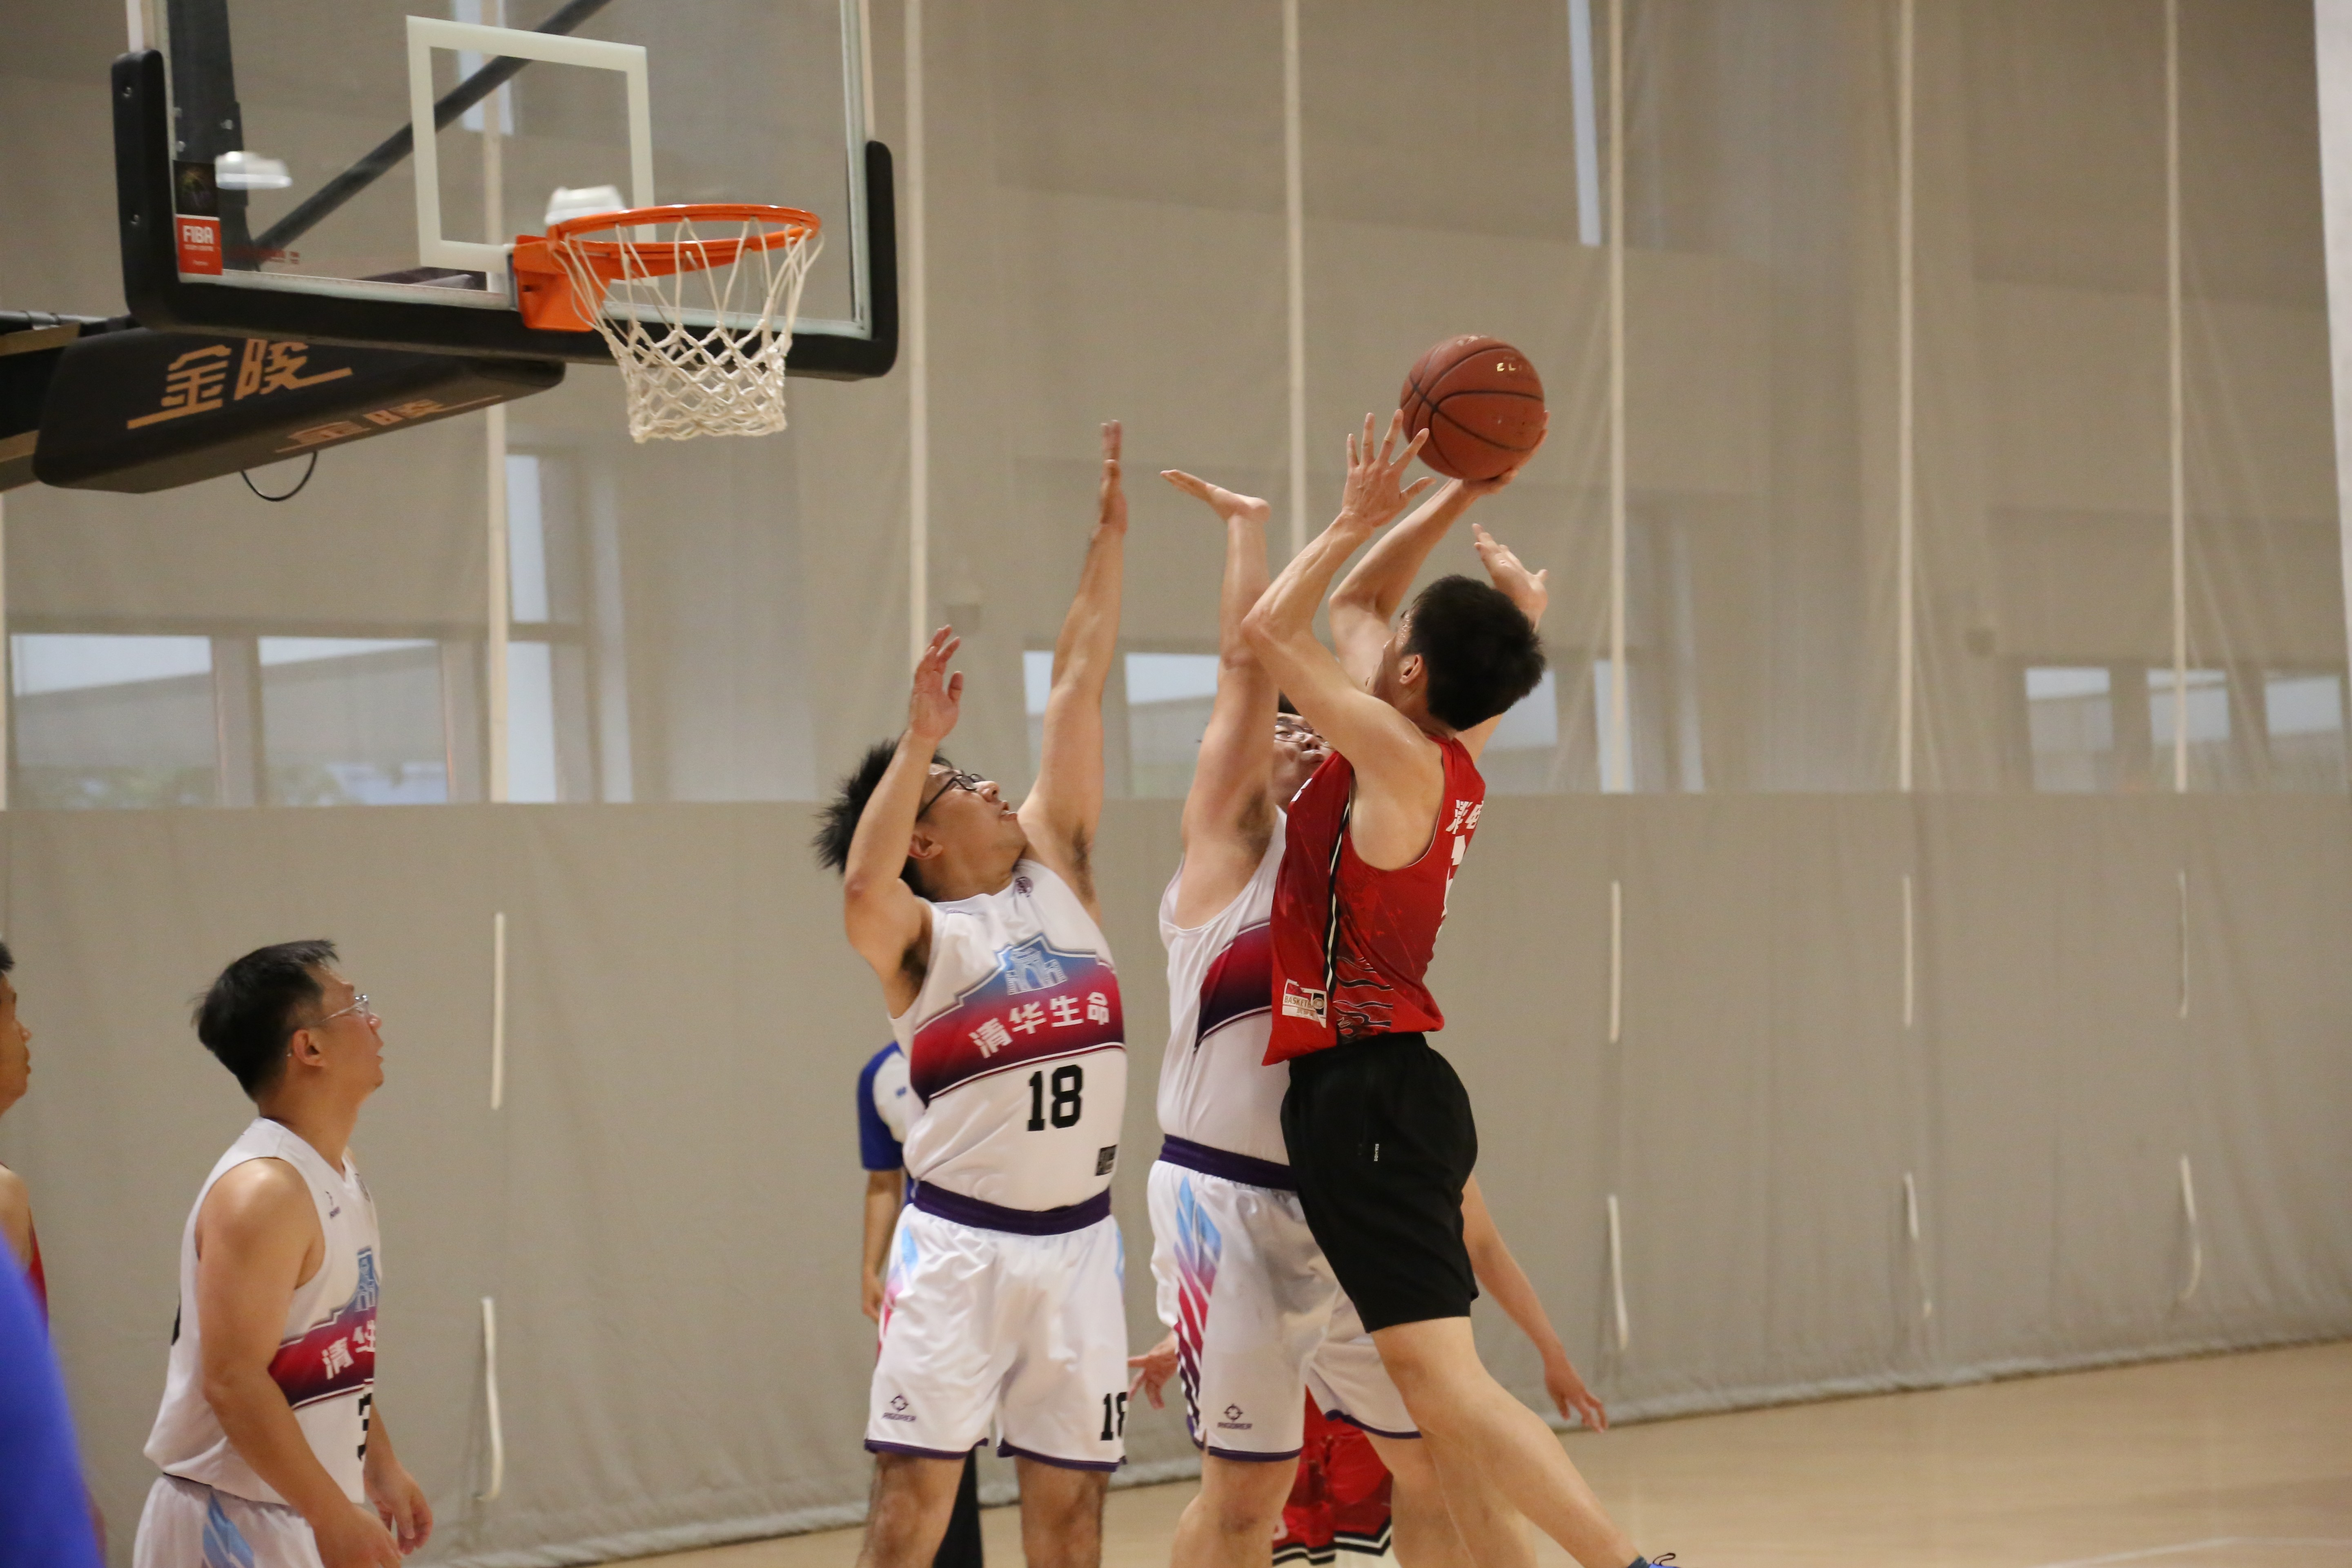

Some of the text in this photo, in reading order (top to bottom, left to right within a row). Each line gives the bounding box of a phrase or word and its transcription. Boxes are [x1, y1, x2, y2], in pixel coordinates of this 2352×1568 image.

[183, 225, 214, 244] FIBA
[127, 339, 352, 430] 金陵
[968, 992, 1109, 1058] 清华生命
[1027, 1064, 1082, 1131] 18
